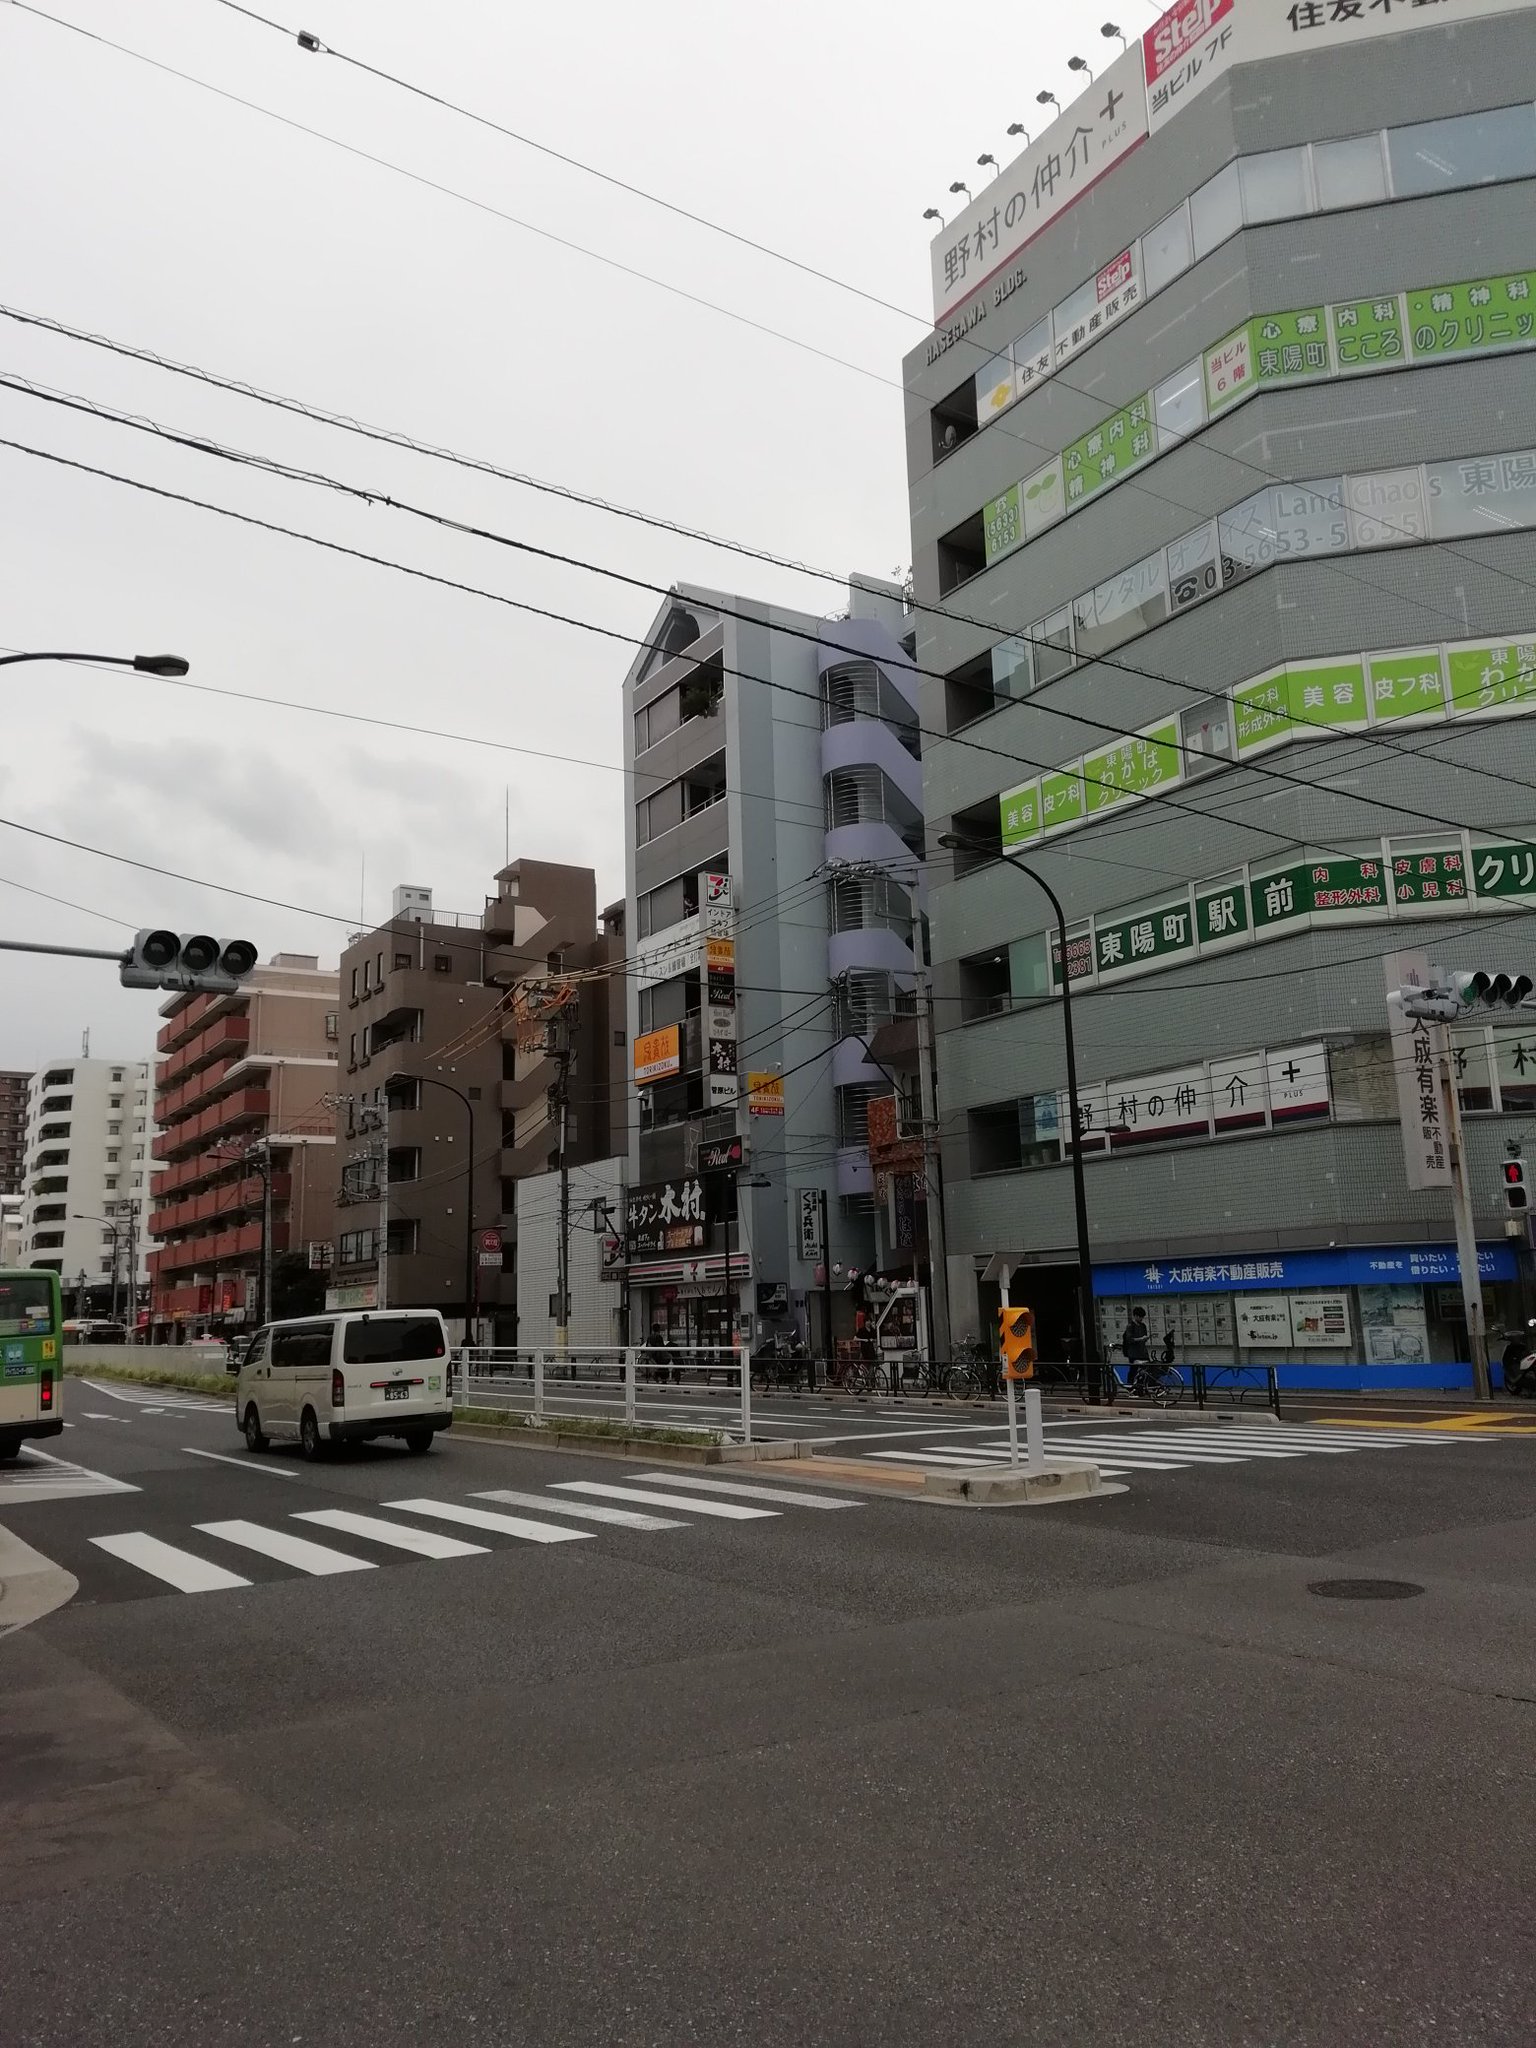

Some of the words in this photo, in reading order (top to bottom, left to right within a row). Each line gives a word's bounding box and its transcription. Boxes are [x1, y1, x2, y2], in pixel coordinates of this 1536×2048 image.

[1152, 59, 1202, 115] 当ビル
[1102, 120, 1127, 149] PLUS
[926, 301, 987, 367] HASEGAWA
[993, 269, 1028, 308] BLDG.
[1211, 341, 1247, 374] 当ビル
[1277, 483, 1344, 520] Land
[1353, 474, 1442, 508] Chaos
[987, 504, 1019, 540] (5633)
[991, 525, 1016, 553] 6153
[1303, 682, 1354, 709] 美容
[1375, 672, 1441, 701] 皮フ科
[1007, 803, 1034, 831] 美容
[1043, 782, 1080, 815] 皮フ科
[1313, 860, 1379, 884] 内科
[1314, 886, 1382, 908] 整形外科
[1397, 879, 1465, 900] 小児科
[1066, 939, 1093, 961] 5665
[1066, 956, 1092, 978] 2381
[628, 1203, 658, 1230] 牛タン
[1168, 1261, 1285, 1284] 大成有楽不動産販売
